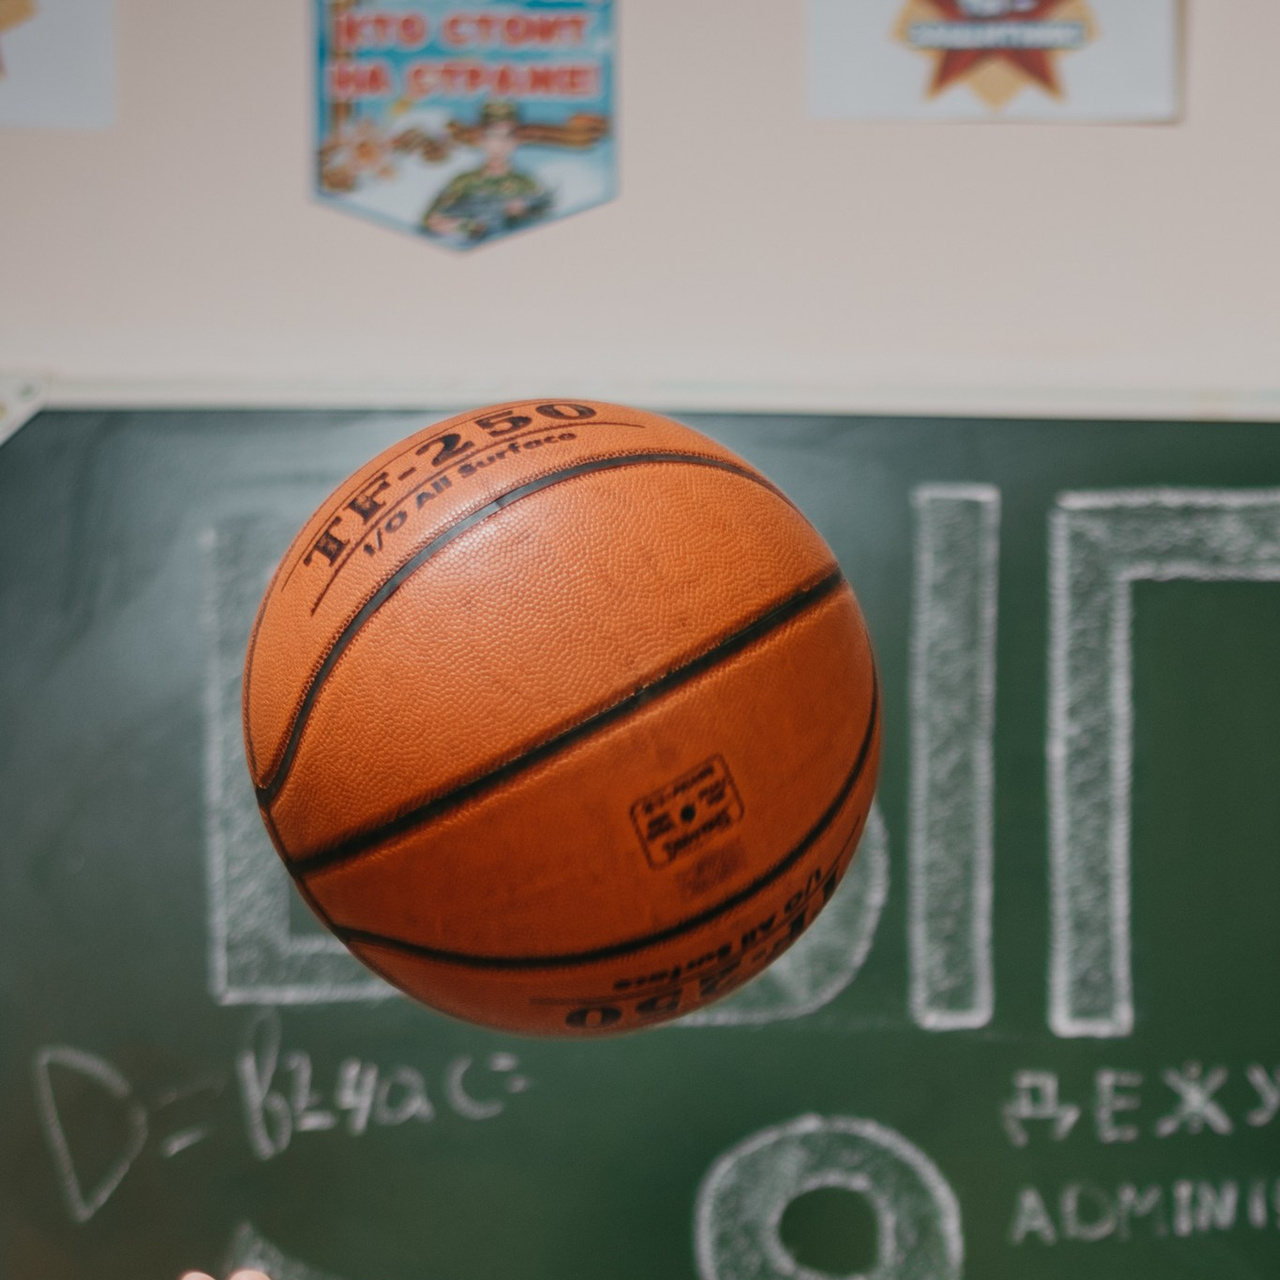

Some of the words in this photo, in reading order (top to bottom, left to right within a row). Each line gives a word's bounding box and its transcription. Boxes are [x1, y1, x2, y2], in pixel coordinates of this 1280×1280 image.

[338, 13, 426, 46] КТО
[443, 13, 590, 46] СТОИТ
[331, 62, 390, 96] НА
[303, 403, 597, 567] TF-250
[363, 510, 408, 557] I/O
[416, 475, 452, 511] All
[458, 432, 577, 479] Surface
